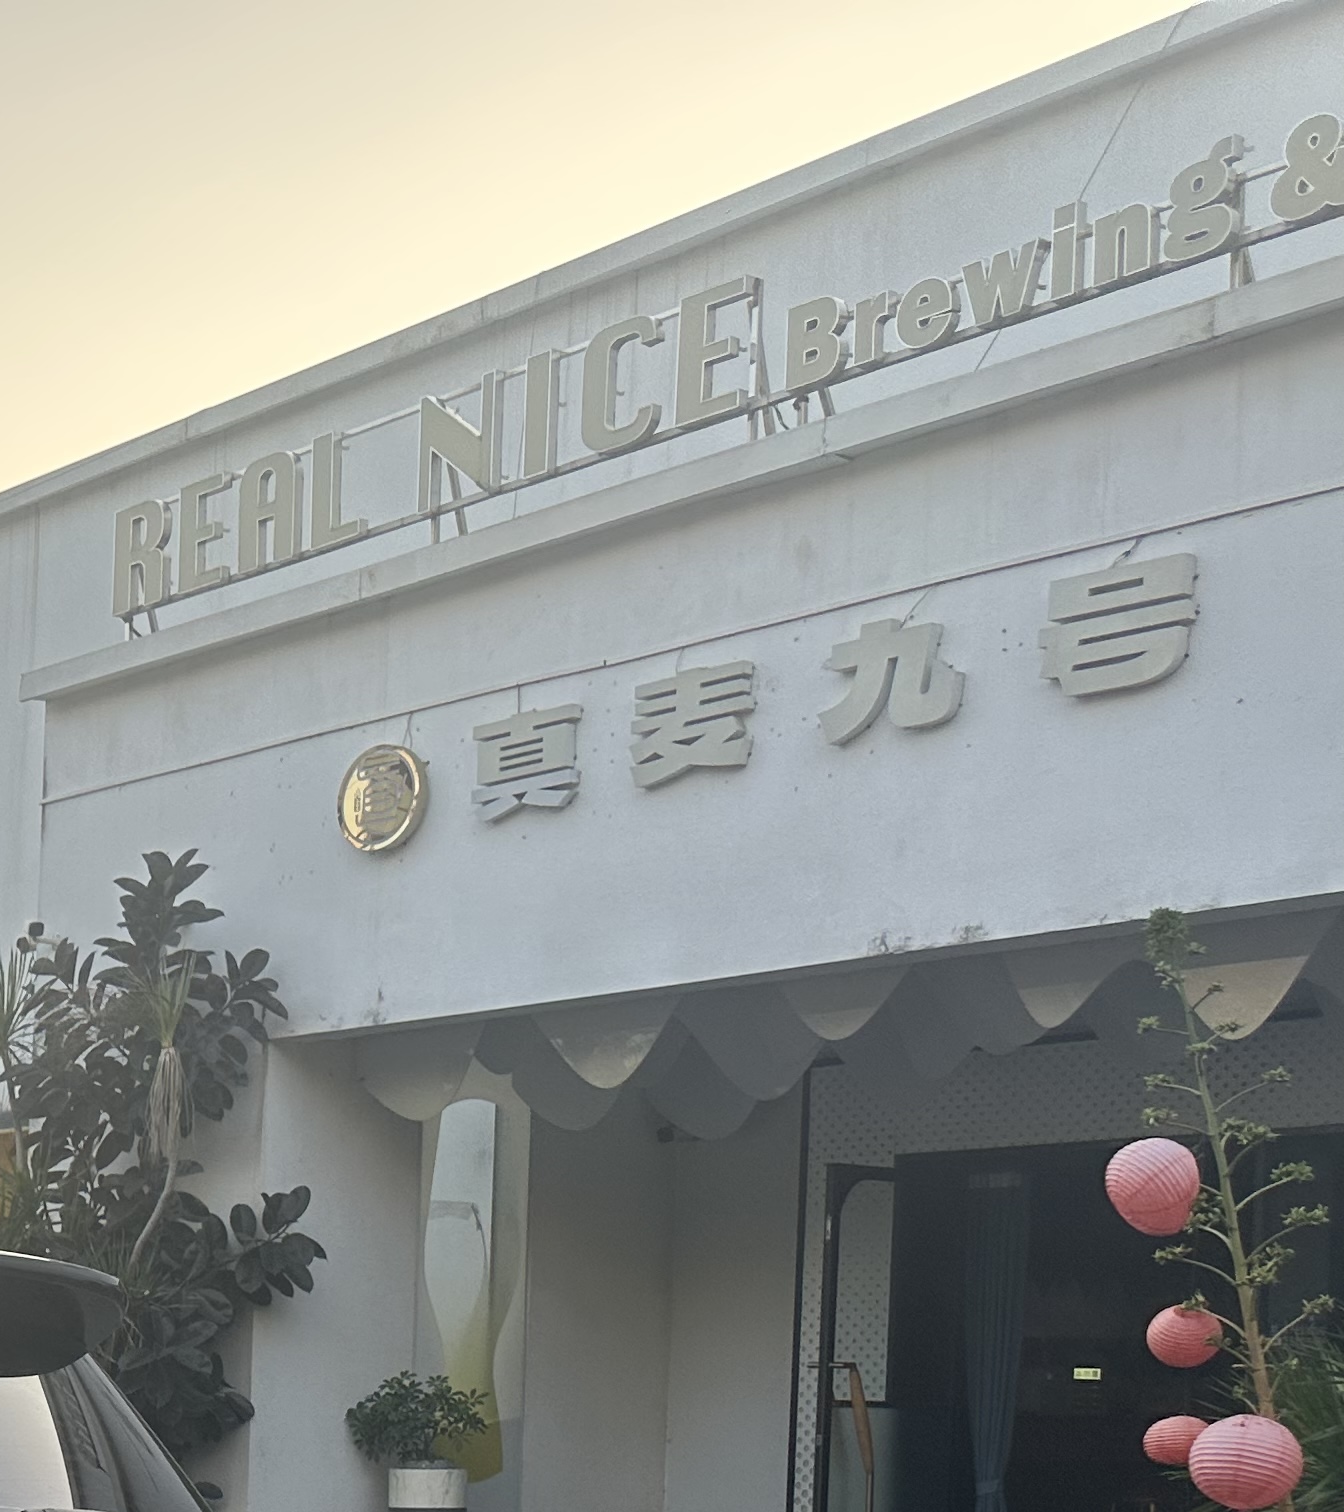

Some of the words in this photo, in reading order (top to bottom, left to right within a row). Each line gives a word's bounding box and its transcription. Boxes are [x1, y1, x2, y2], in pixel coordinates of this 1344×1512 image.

[112, 431, 368, 617] REAL
[417, 274, 763, 513] NICE
[785, 133, 1252, 392] Brewing
[1268, 111, 1344, 221] &
[471, 552, 1197, 825] 真麦九号
